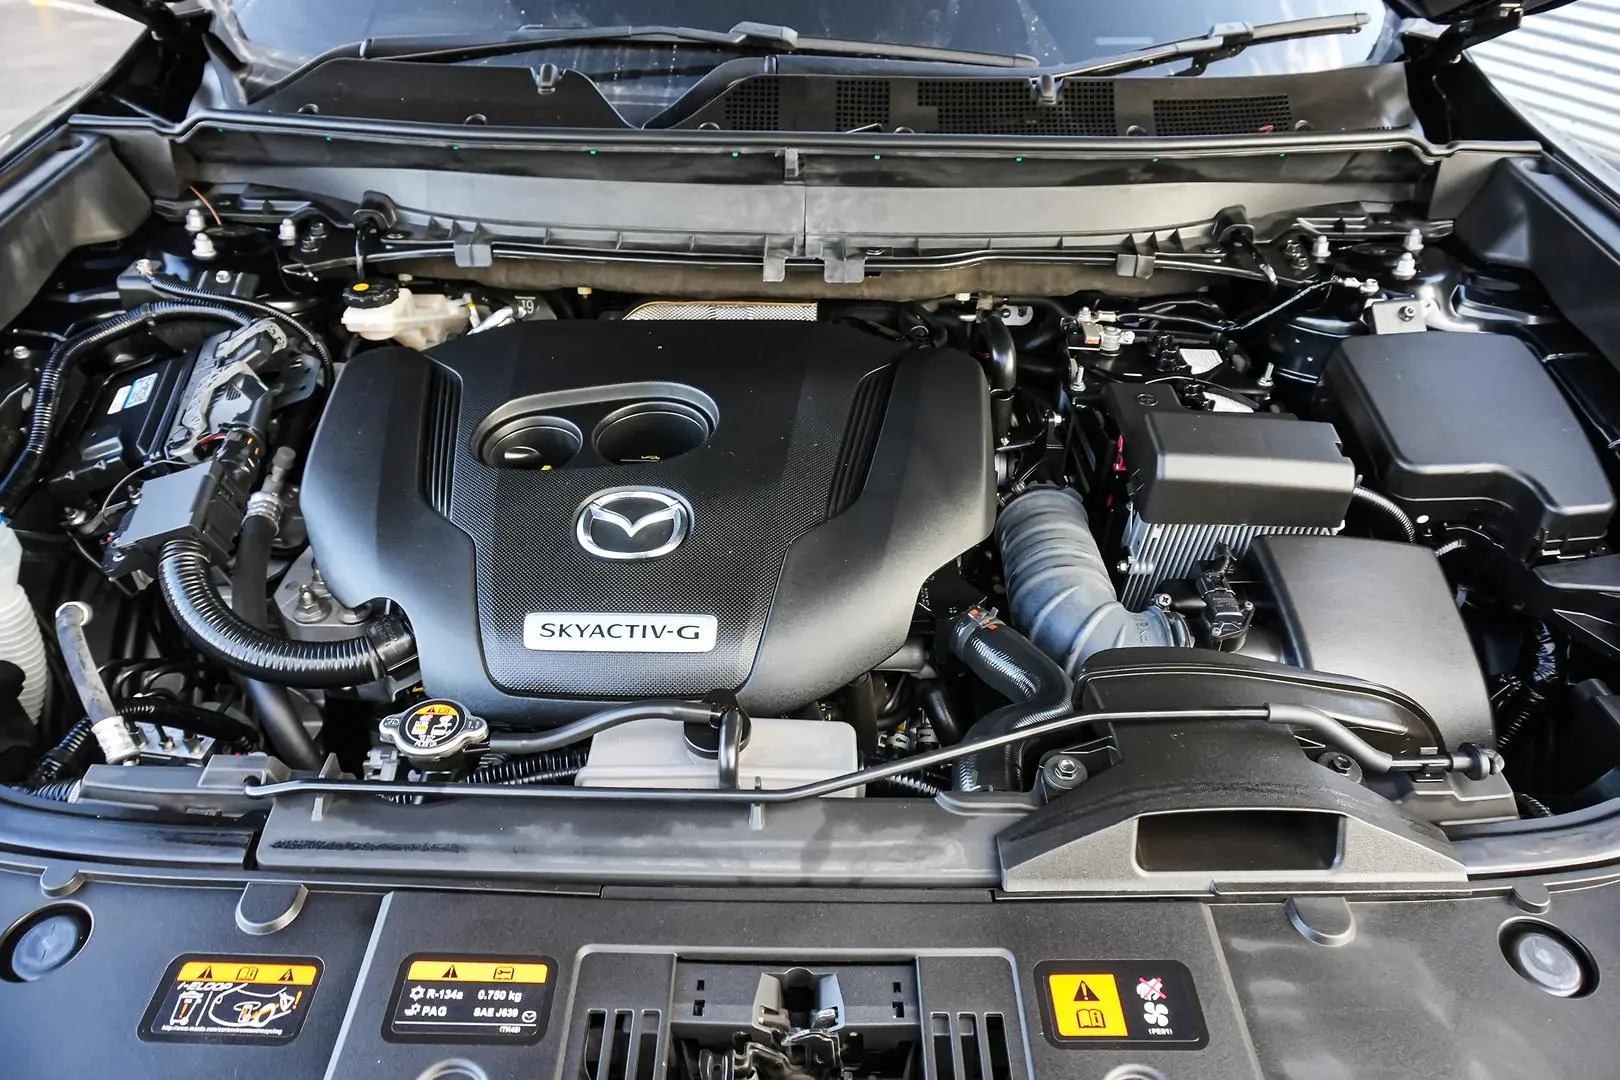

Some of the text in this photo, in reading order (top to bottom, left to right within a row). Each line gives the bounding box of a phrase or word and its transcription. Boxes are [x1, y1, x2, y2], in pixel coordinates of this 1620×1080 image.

[539, 622, 700, 640] SKYACTIV-G
[425, 988, 464, 1000] R-134a
[508, 989, 523, 1003] kg
[421, 1005, 448, 1017] PAG
[473, 1006, 495, 1017] SAE
